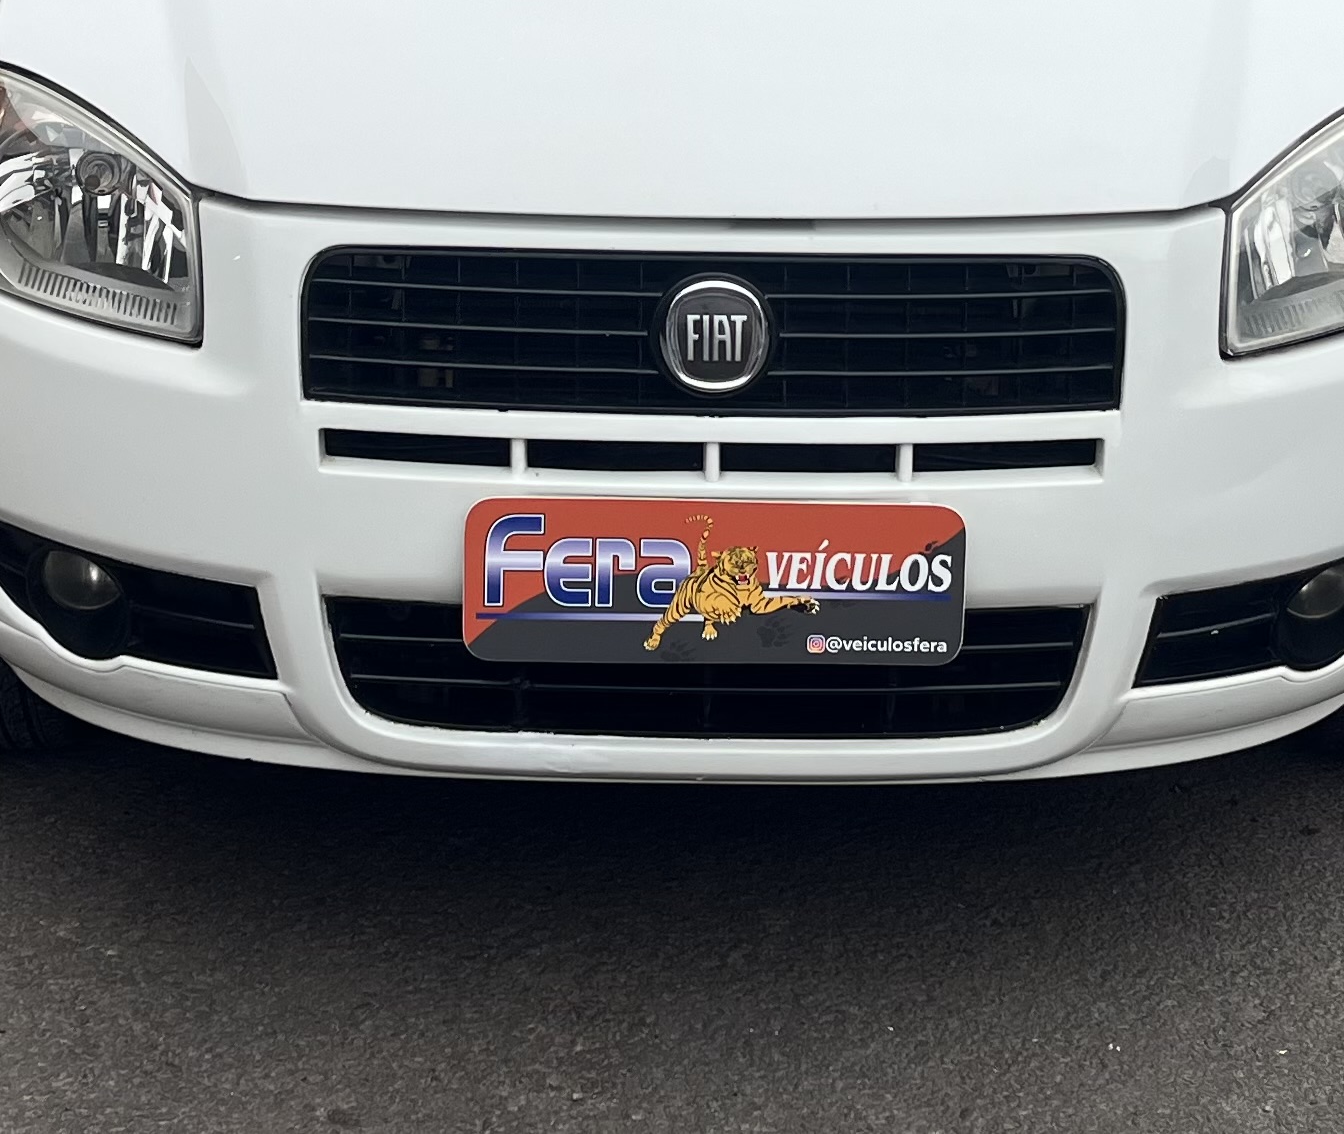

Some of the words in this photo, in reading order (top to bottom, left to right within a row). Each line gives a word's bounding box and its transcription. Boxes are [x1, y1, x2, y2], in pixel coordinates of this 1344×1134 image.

[686, 314, 748, 362] FIAT
[484, 514, 692, 608] Fera
[766, 539, 953, 594] VEÍCULOS
[825, 635, 948, 654] @veiculosfera
